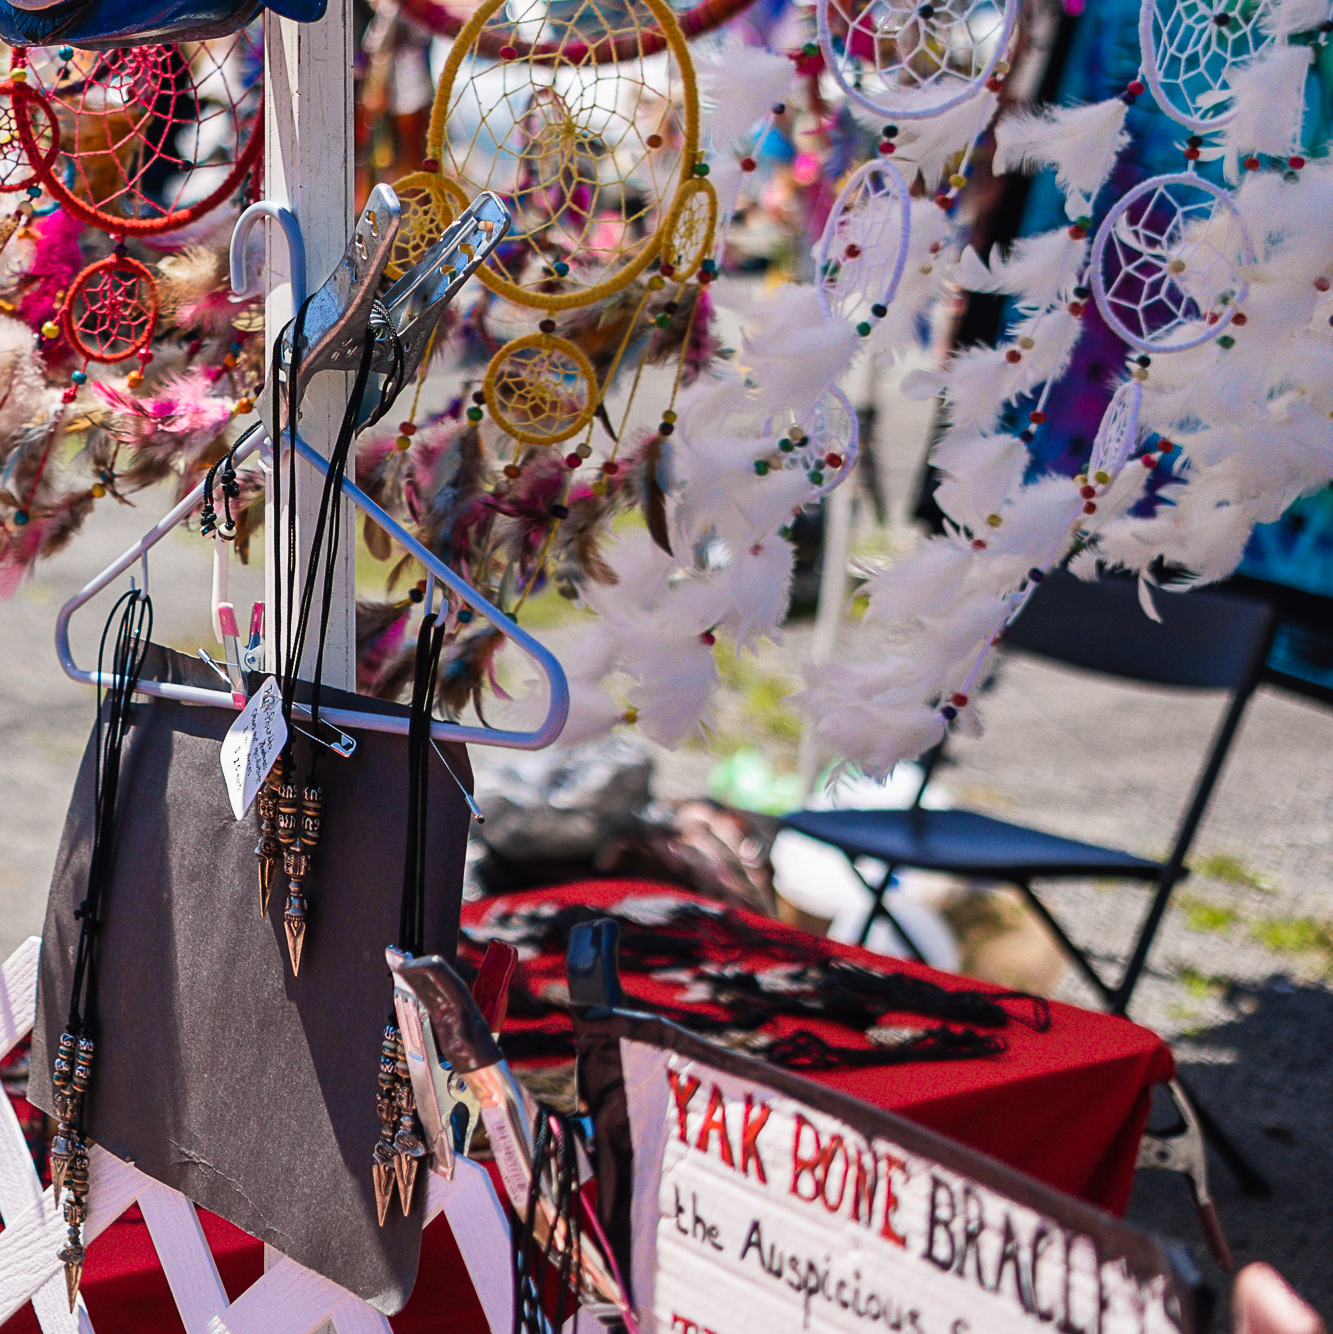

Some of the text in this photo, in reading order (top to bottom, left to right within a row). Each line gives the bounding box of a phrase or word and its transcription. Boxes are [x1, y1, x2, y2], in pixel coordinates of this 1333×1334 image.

[667, 1068, 768, 1185] YAK
[789, 1112, 908, 1250] BONE
[673, 1183, 925, 1334] the Auspicious
